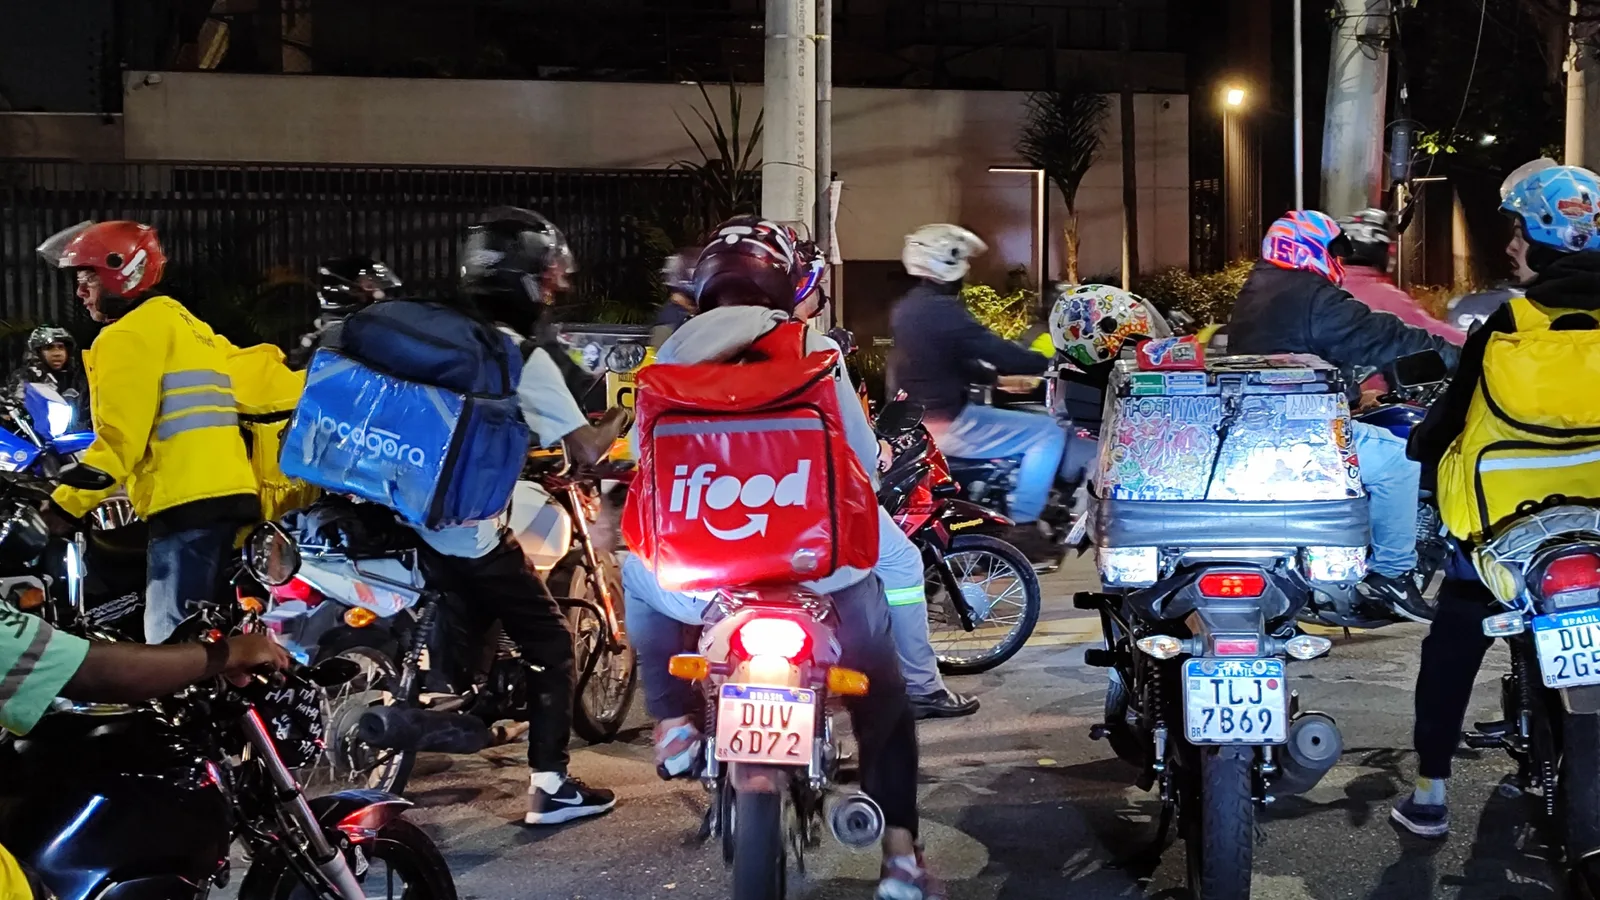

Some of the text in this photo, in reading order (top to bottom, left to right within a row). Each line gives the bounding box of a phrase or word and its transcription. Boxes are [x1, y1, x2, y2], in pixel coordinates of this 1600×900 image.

[669, 459, 812, 520] ifood
[1561, 614, 1599, 627] BRASIL
[1209, 679, 1263, 705] TLJ
[1546, 674, 1557, 685] BR
[749, 691, 784, 702] BRASIL
[740, 702, 793, 730] DUV
[1201, 707, 1272, 734] 7B69
[729, 730, 801, 757] 6D72
